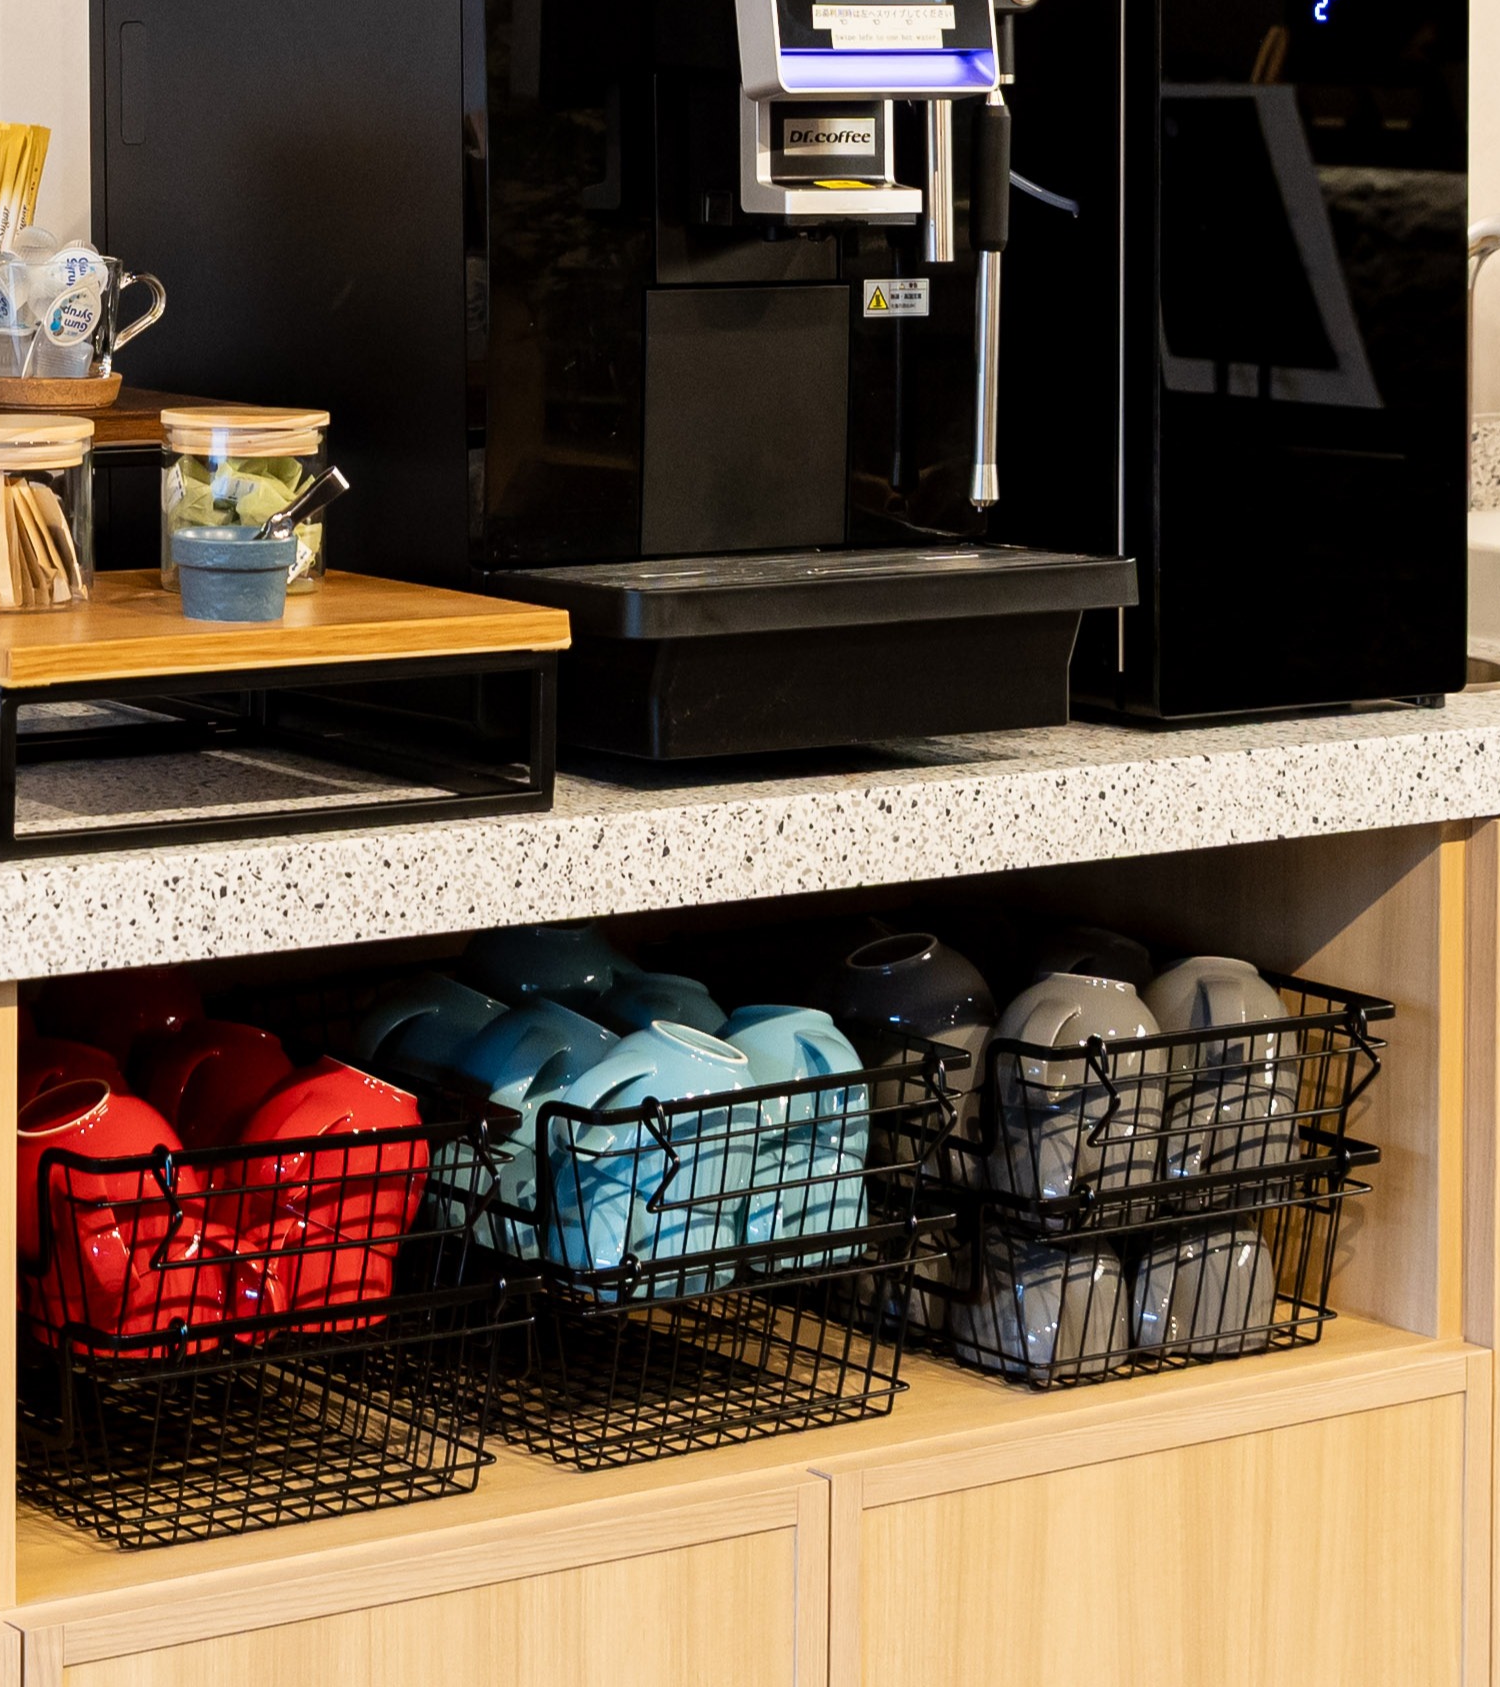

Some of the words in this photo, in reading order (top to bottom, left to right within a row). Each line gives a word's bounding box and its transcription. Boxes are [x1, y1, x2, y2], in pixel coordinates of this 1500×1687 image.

[789, 130, 871, 144] Dr.coffee
[79, 257, 89, 276] Gu
[62, 305, 93, 323] Syrup
[64, 318, 88, 332] Gum
